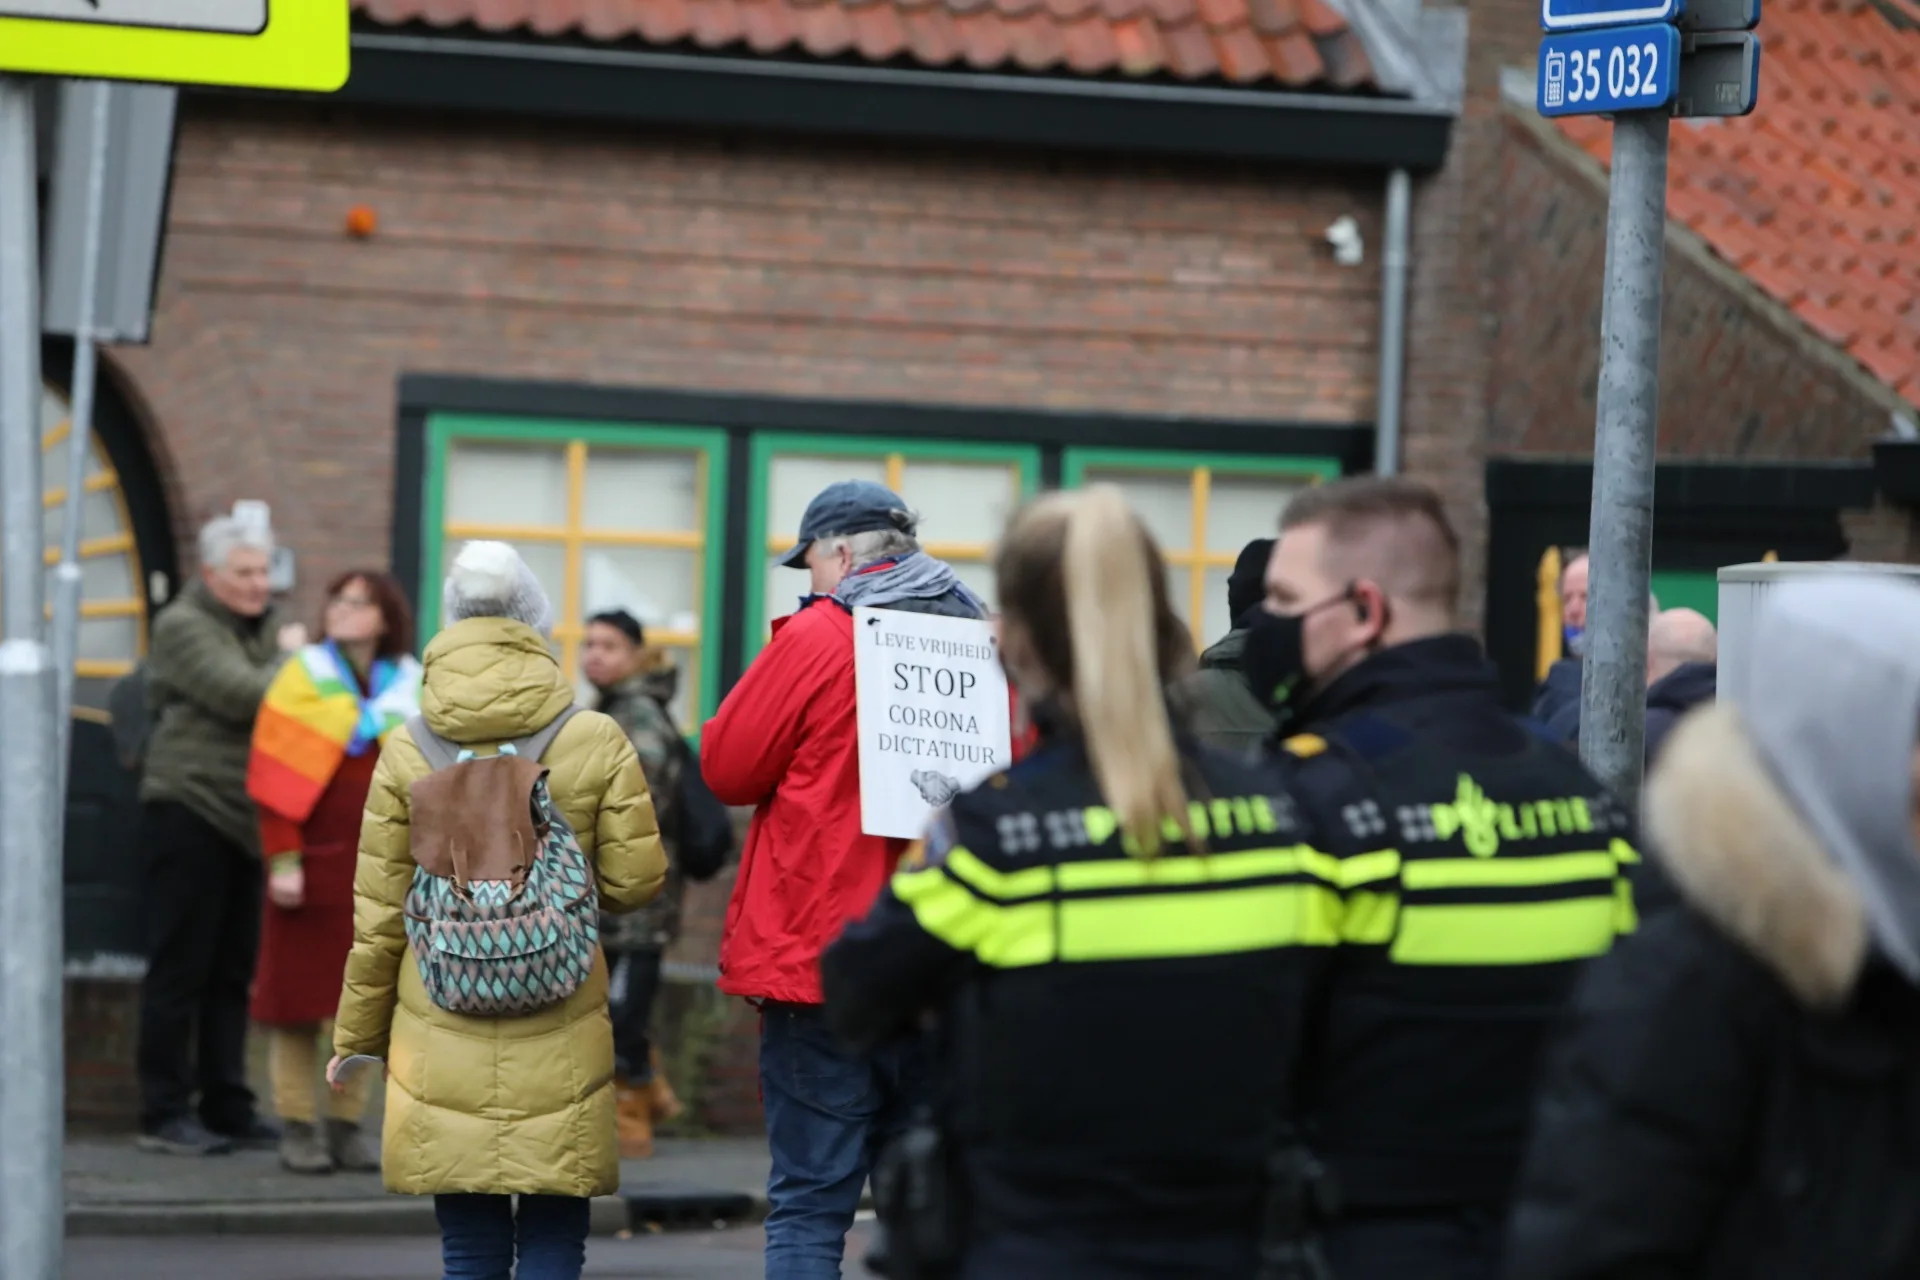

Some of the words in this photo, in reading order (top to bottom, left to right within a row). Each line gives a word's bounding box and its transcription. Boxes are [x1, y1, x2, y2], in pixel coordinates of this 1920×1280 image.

[1568, 49, 1601, 102] 35
[1608, 42, 1659, 99] 032
[875, 631, 915, 651] LEVE
[919, 637, 992, 660] VRIJHEID
[893, 662, 976, 698] STOP
[889, 704, 980, 735] CORONA
[878, 733, 996, 765] DICTATUUR
